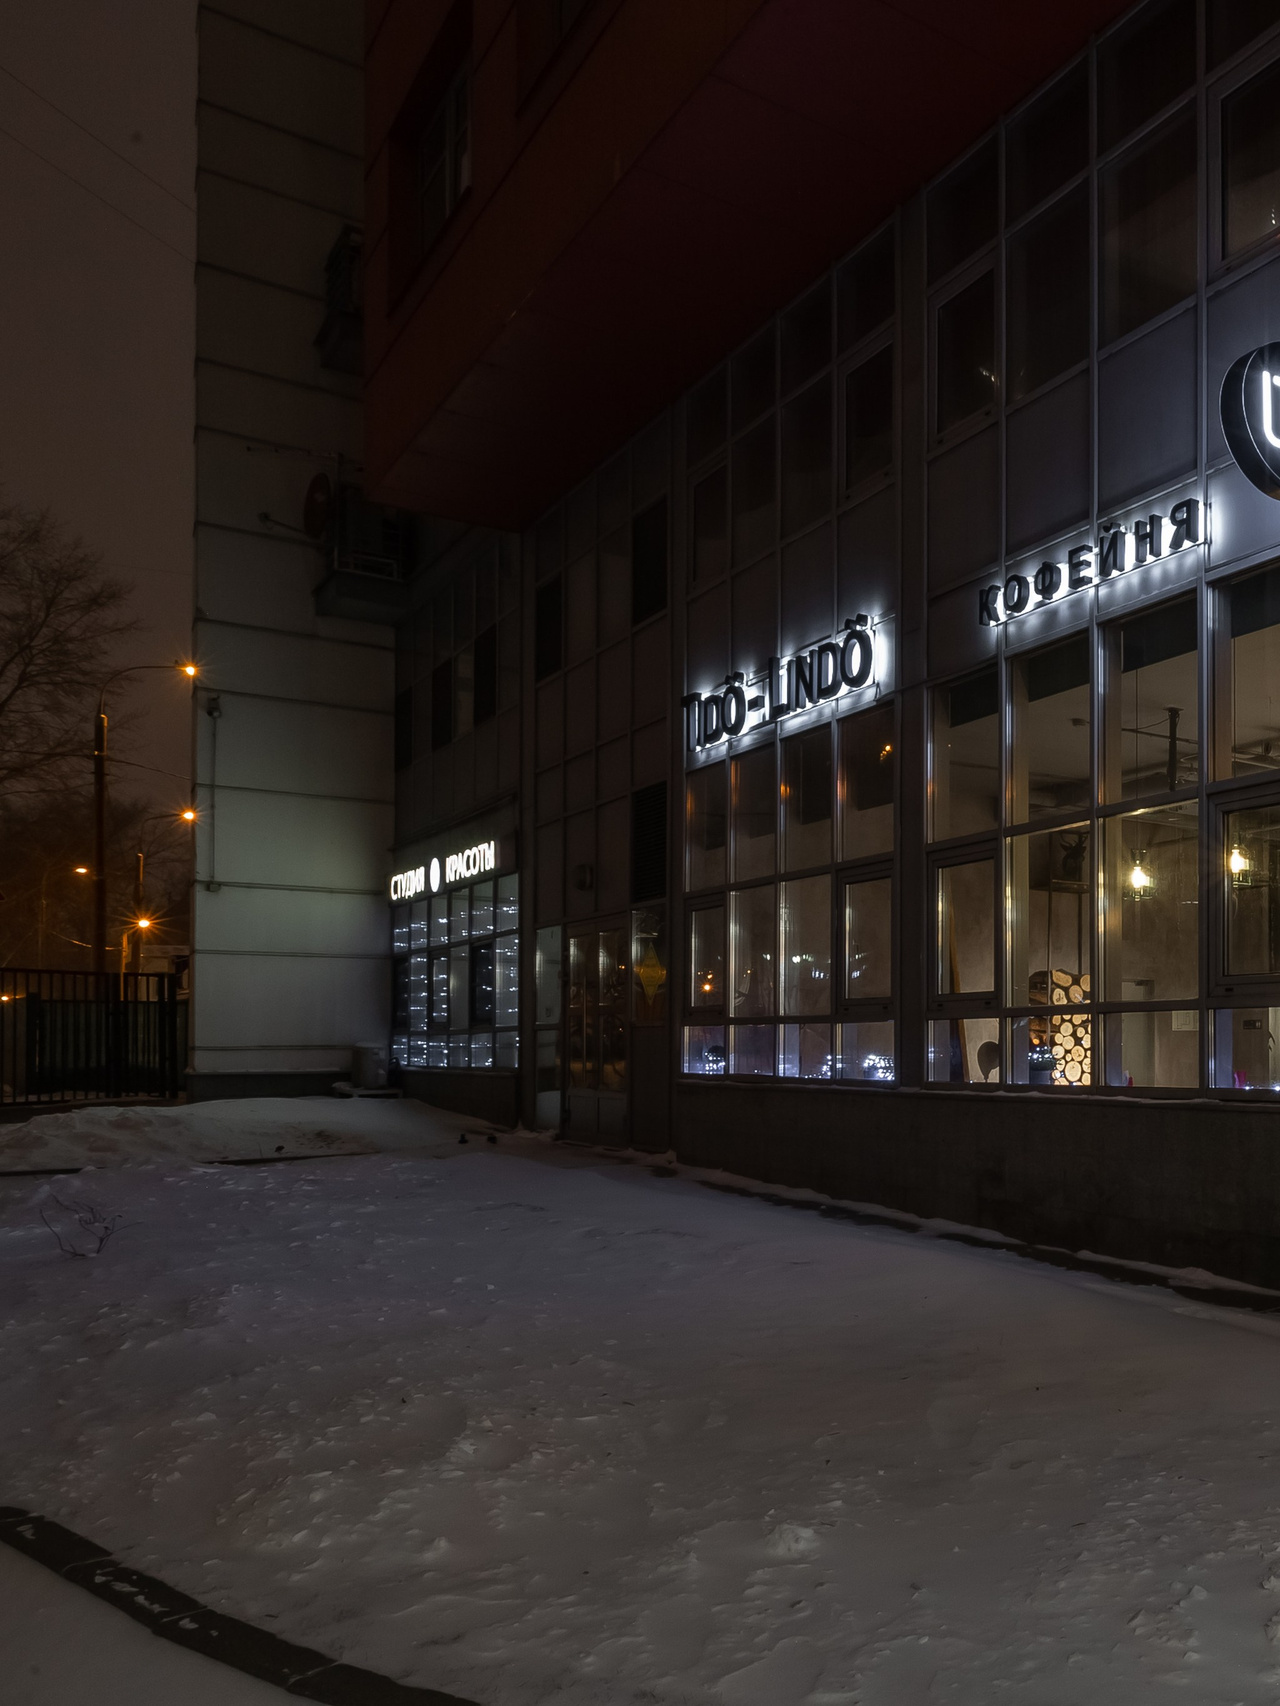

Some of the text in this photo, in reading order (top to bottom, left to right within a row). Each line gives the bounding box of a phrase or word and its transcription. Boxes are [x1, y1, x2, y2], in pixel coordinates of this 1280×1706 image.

[979, 498, 1200, 626] КОФЕЙНЯ
[390, 840, 495, 900] СТУДИЯ КРАСОТЫ
